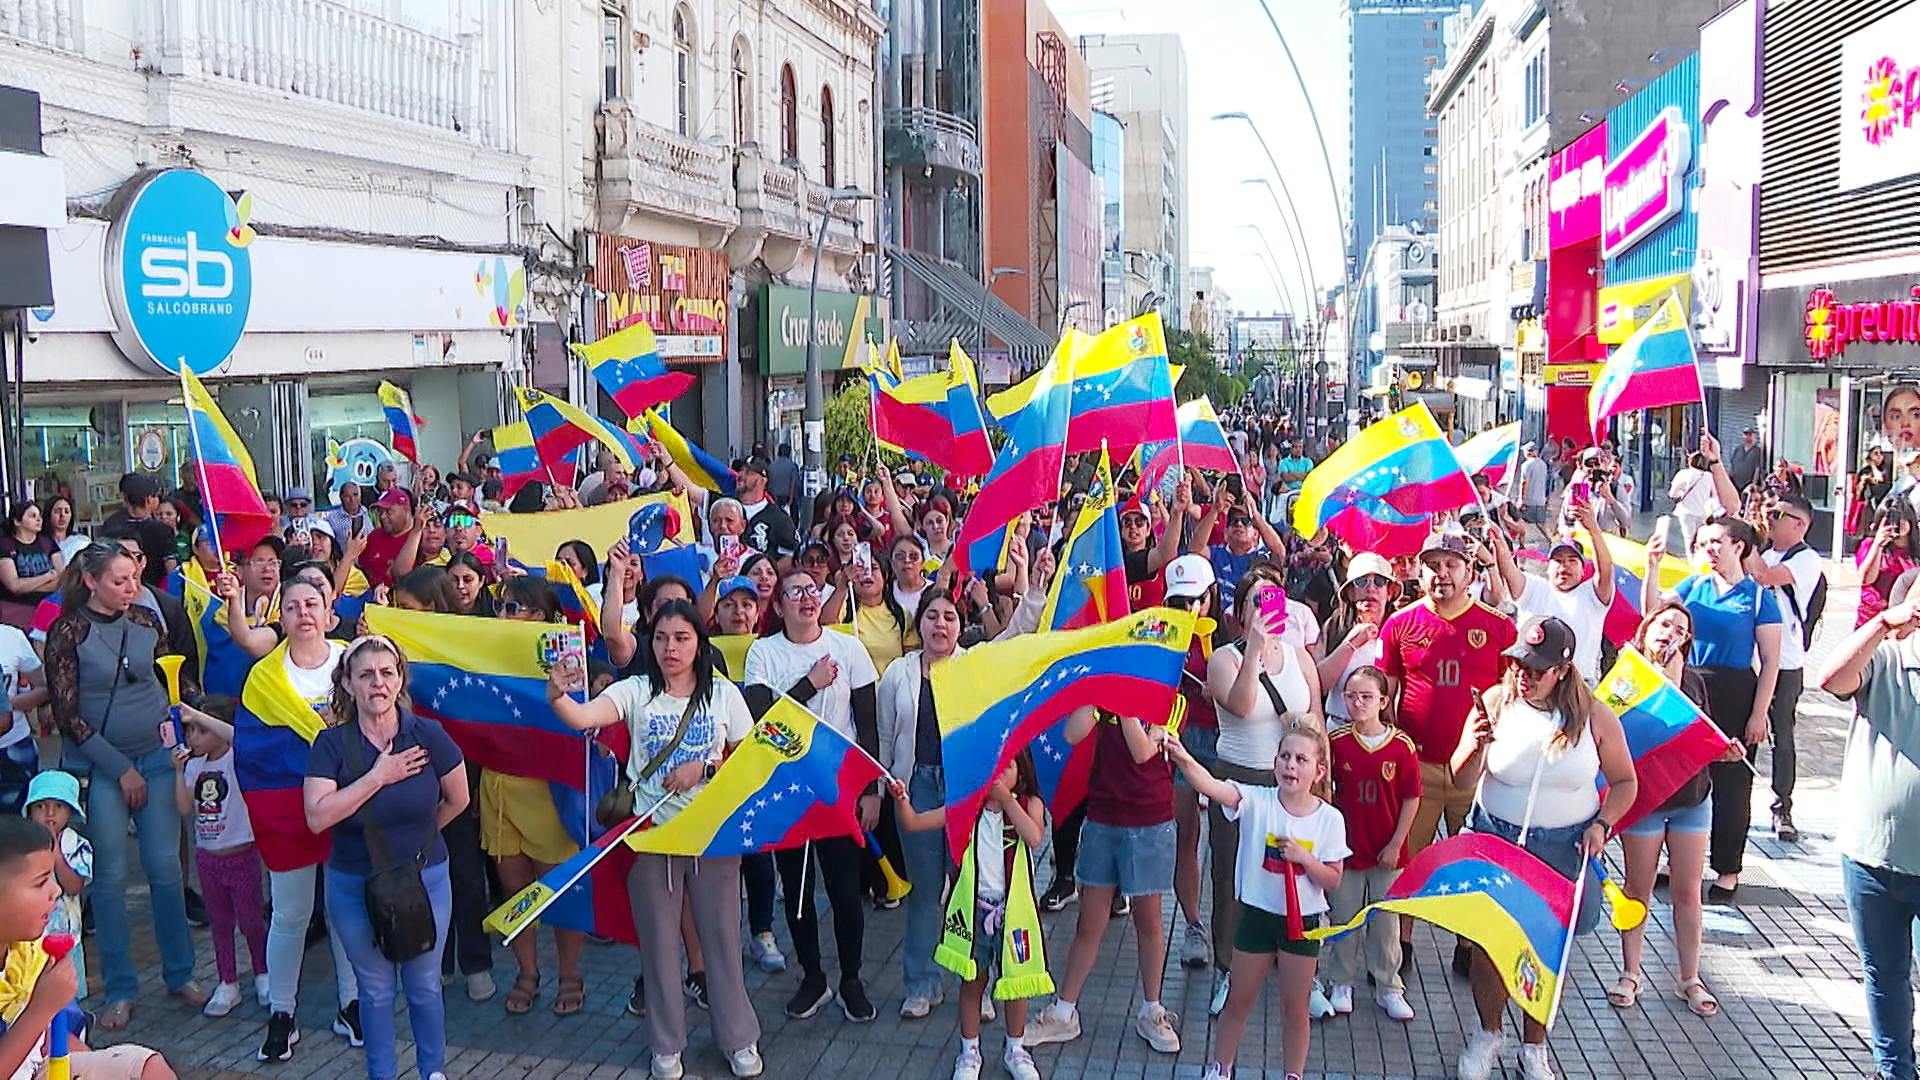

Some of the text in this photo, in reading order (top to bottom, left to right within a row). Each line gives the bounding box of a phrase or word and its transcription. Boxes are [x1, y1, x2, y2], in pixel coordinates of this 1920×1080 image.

[141, 233, 187, 245] FARMACIAS
[141, 230, 234, 298] sb
[147, 301, 233, 315] SALCOBRAND
[606, 291, 727, 332] MALL CHINO
[1436, 659, 1460, 687] 10
[1357, 779, 1378, 804] 10
